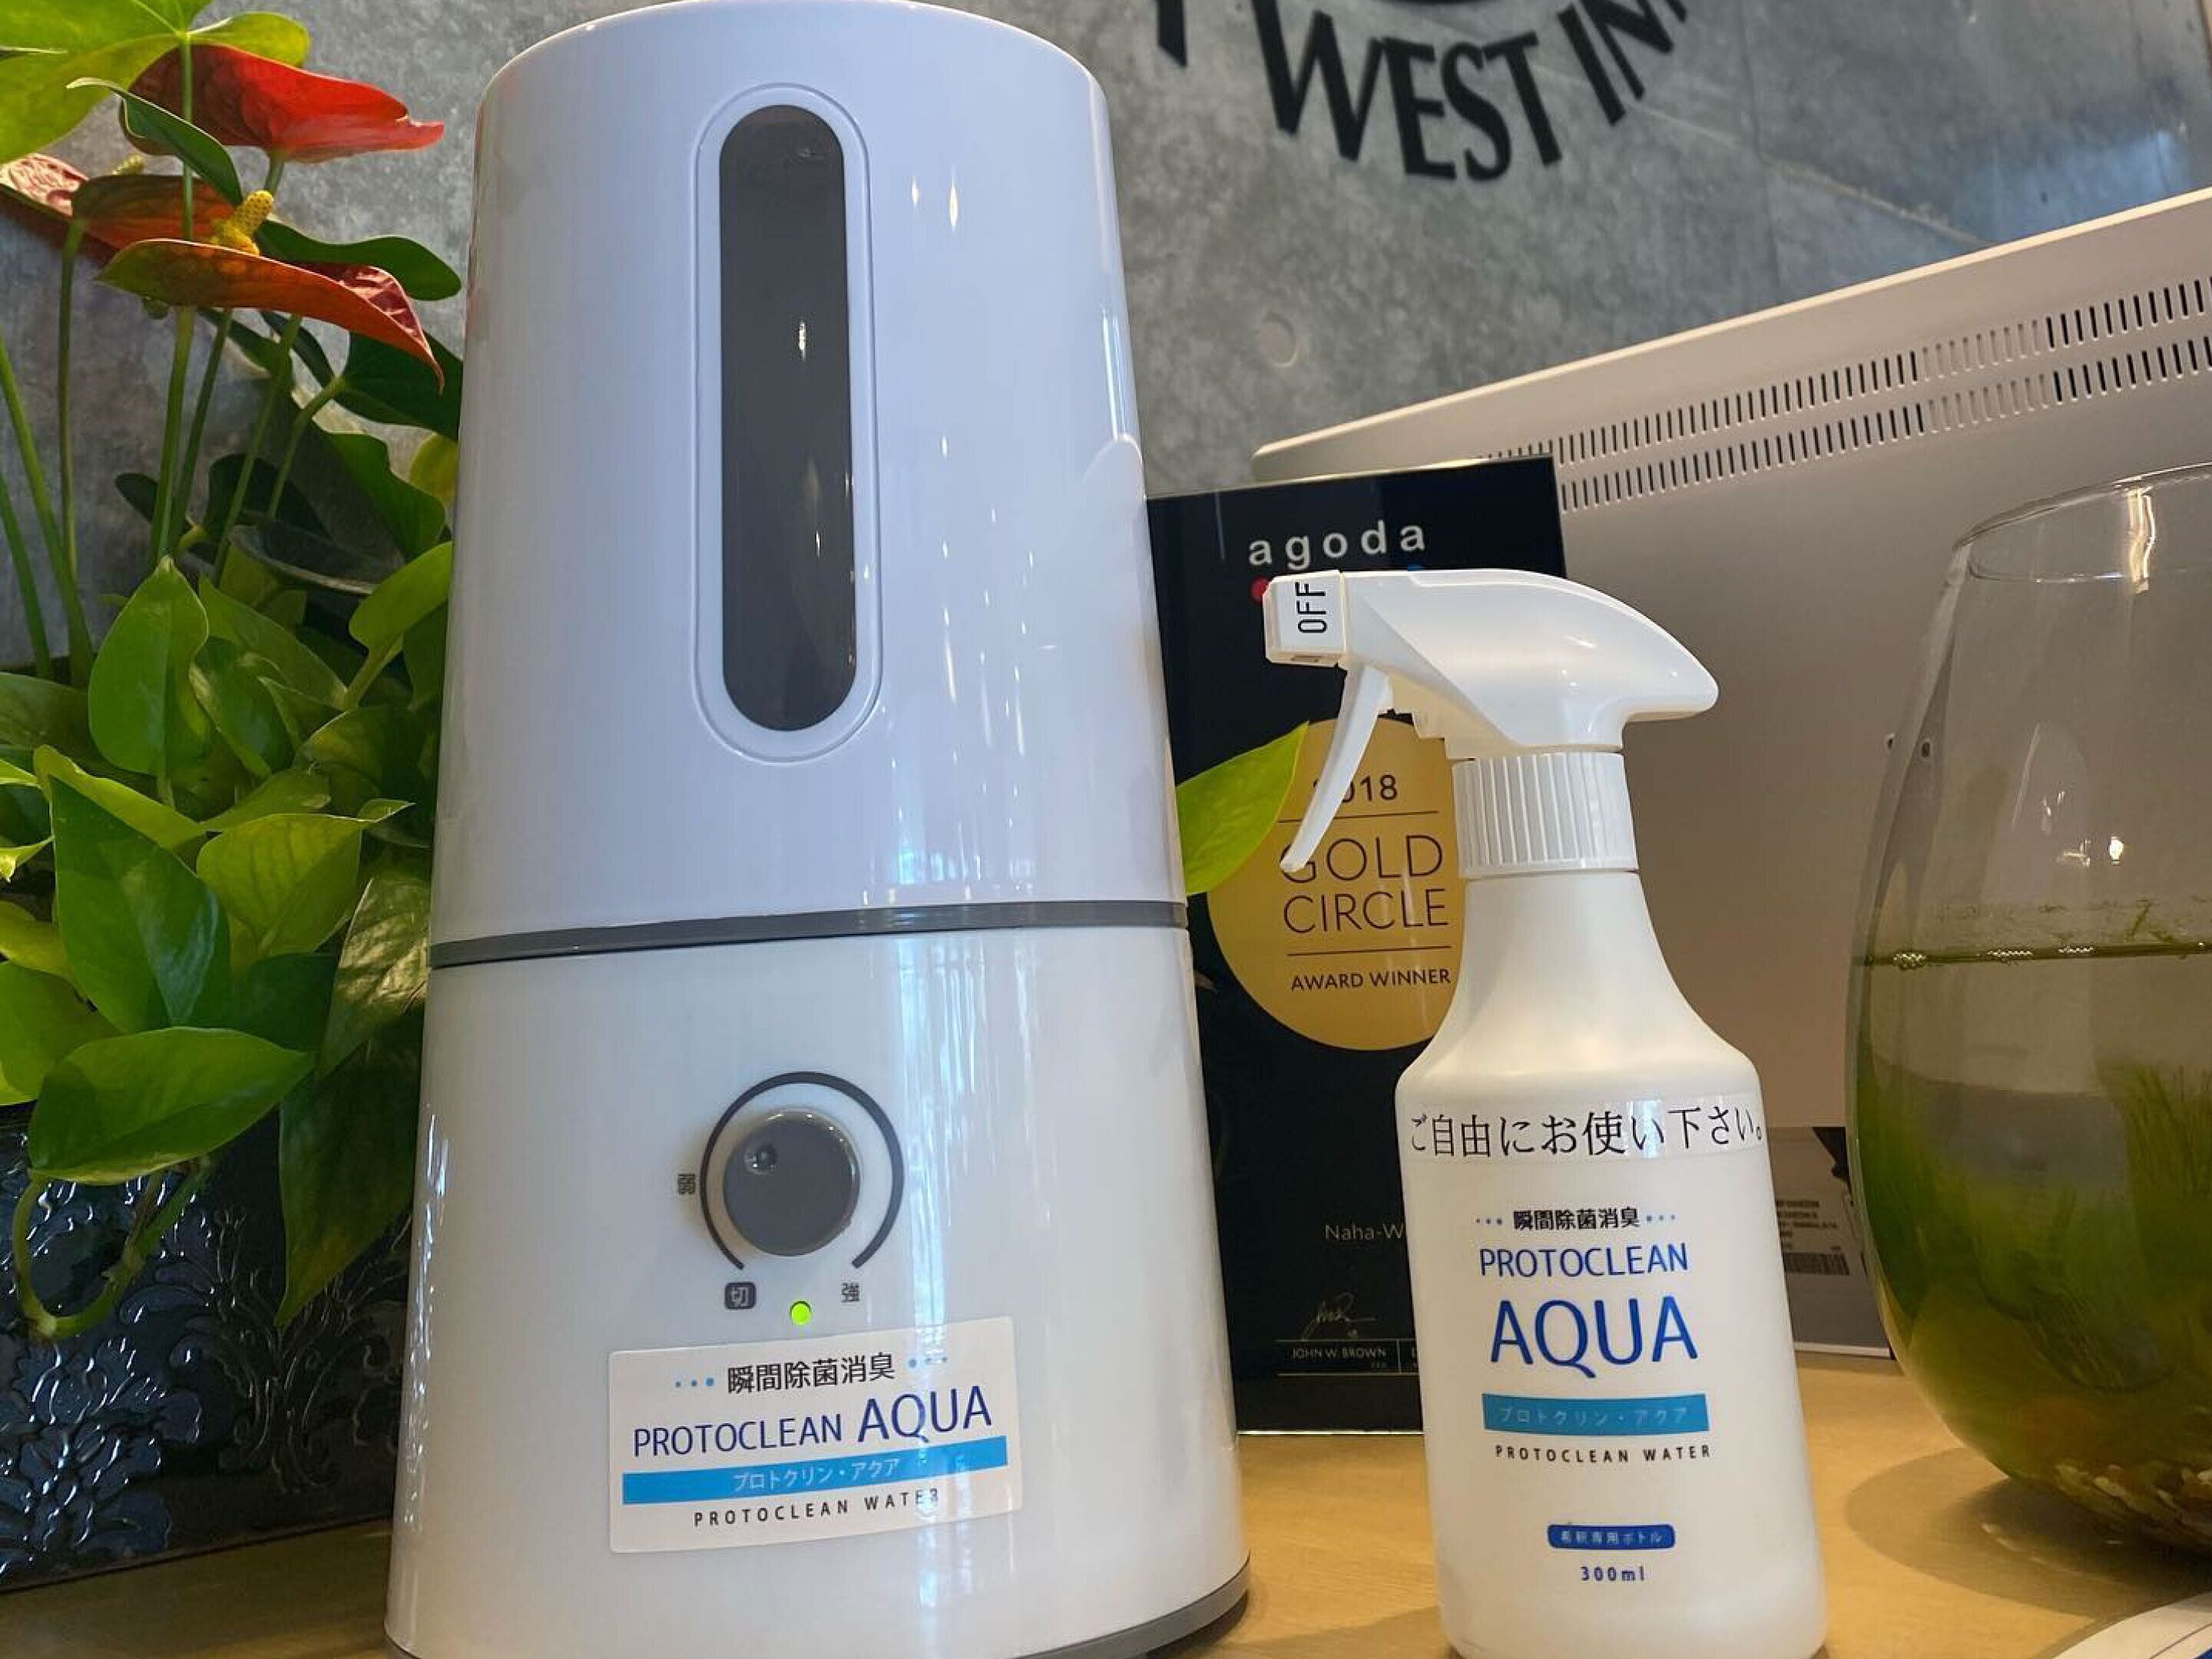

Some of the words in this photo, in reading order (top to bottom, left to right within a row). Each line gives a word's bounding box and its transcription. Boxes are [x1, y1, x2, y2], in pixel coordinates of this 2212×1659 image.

[1252, 0, 1562, 182] WEST
[1557, 0, 1687, 126] IN
[1248, 519, 1426, 571] agoda
[1295, 581, 1327, 634] OFF
[1313, 774, 1398, 803] 18
[1283, 888, 1450, 934] CIRCLE
[1291, 972, 1364, 992] AWARD
[1369, 969, 1452, 988] WINNER
[1411, 1106, 1763, 1157] ご自由にお使い下さい。
[1512, 1206, 1641, 1230] 瞬間除菌消臭
[1480, 1243, 1688, 1277] PROTOCLEAN
[840, 1282, 860, 1303] 強
[1292, 1347, 1322, 1359] JOHN
[1490, 1295, 1699, 1379] AQUA
[727, 1352, 896, 1396] 瞬間除菌消臭
[634, 1413, 843, 1458] PROTOCLEAN
[857, 1385, 992, 1443] AQUA
[1495, 1444, 1629, 1463] PROTOCLEAN
[1643, 1444, 1711, 1462] WATER
[733, 1458, 900, 1493] プロトクリン・アクア
[694, 1499, 849, 1528] PROTOCLEAN
[865, 1487, 941, 1511] WATER
[1580, 1565, 1646, 1582] 300ml
